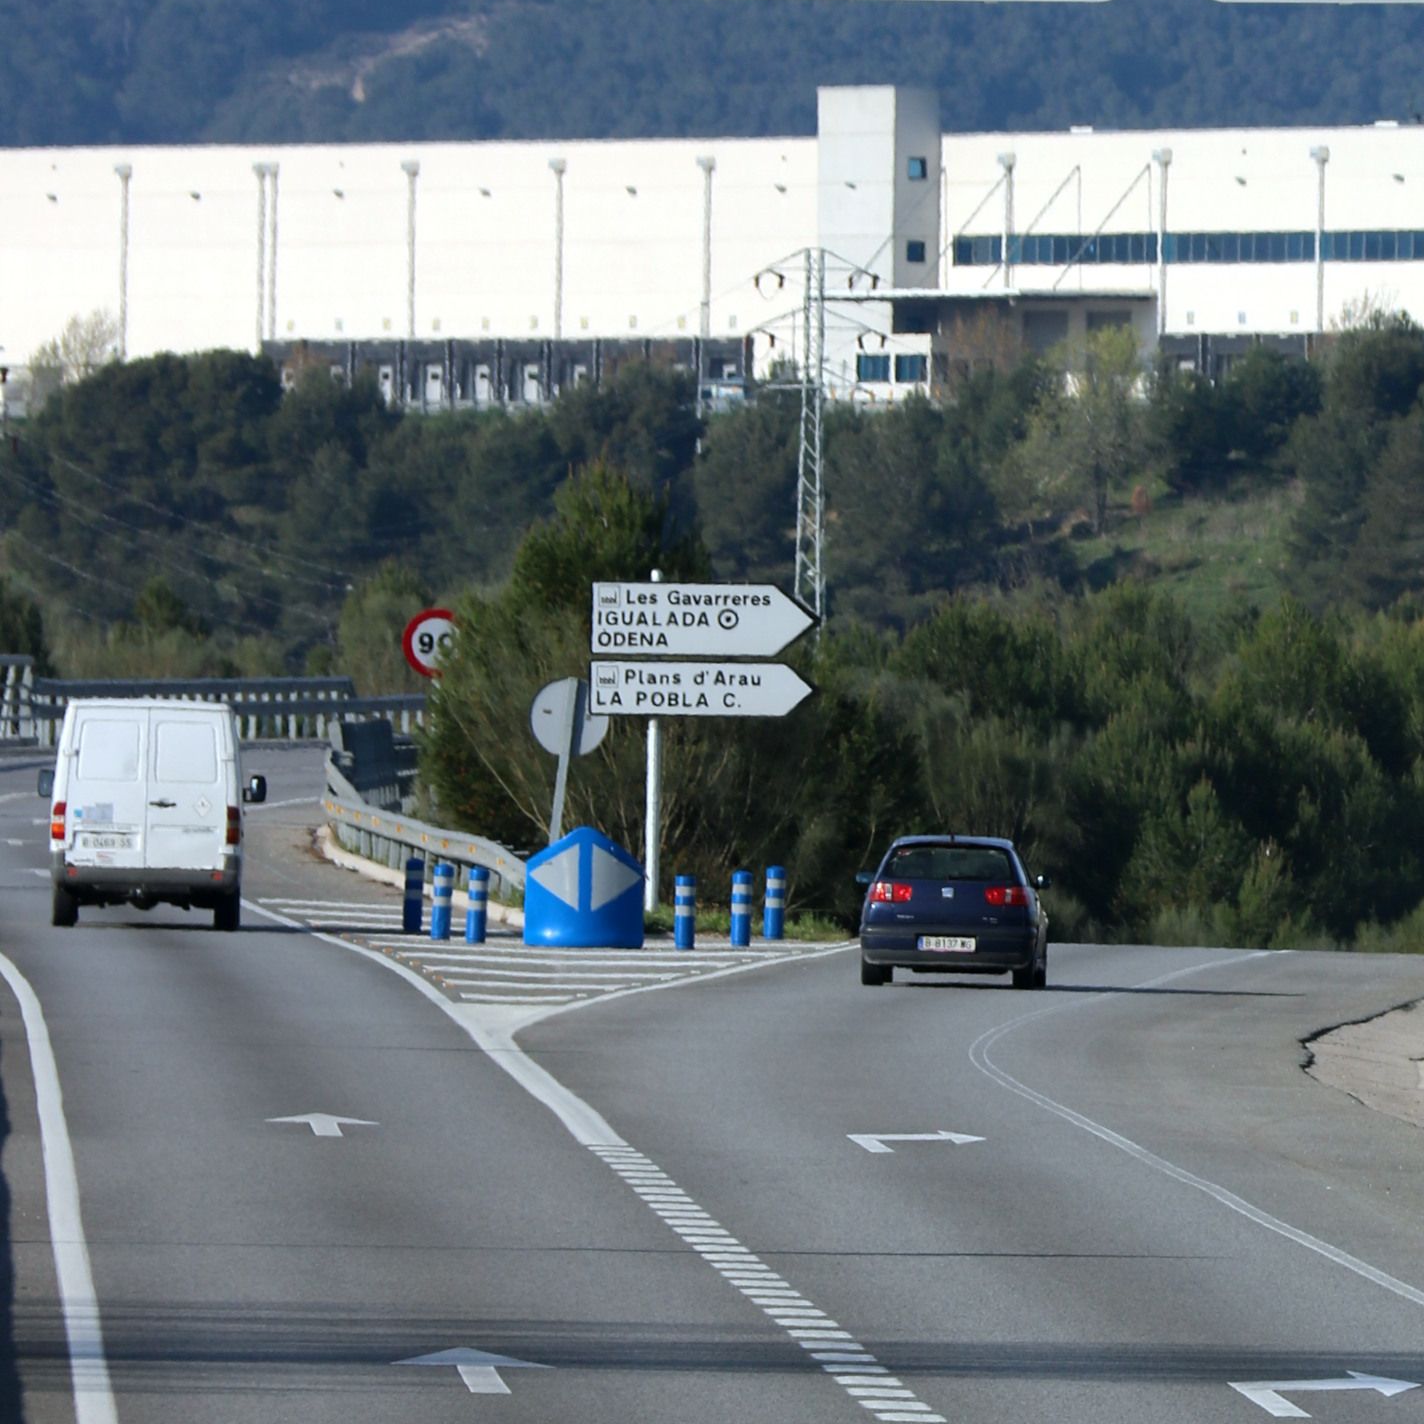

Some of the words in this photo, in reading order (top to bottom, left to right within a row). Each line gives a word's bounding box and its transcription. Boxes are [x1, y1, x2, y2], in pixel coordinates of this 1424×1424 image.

[626, 589, 657, 605] Les
[667, 590, 771, 606] Gavarreres
[598, 611, 710, 627] IGUALADA
[598, 628, 668, 647] ÒDENA
[625, 669, 681, 685] Plans
[693, 670, 761, 686] d'Arau
[597, 691, 623, 706] LA
[636, 692, 709, 708] POBLA
[723, 693, 742, 708] C.
